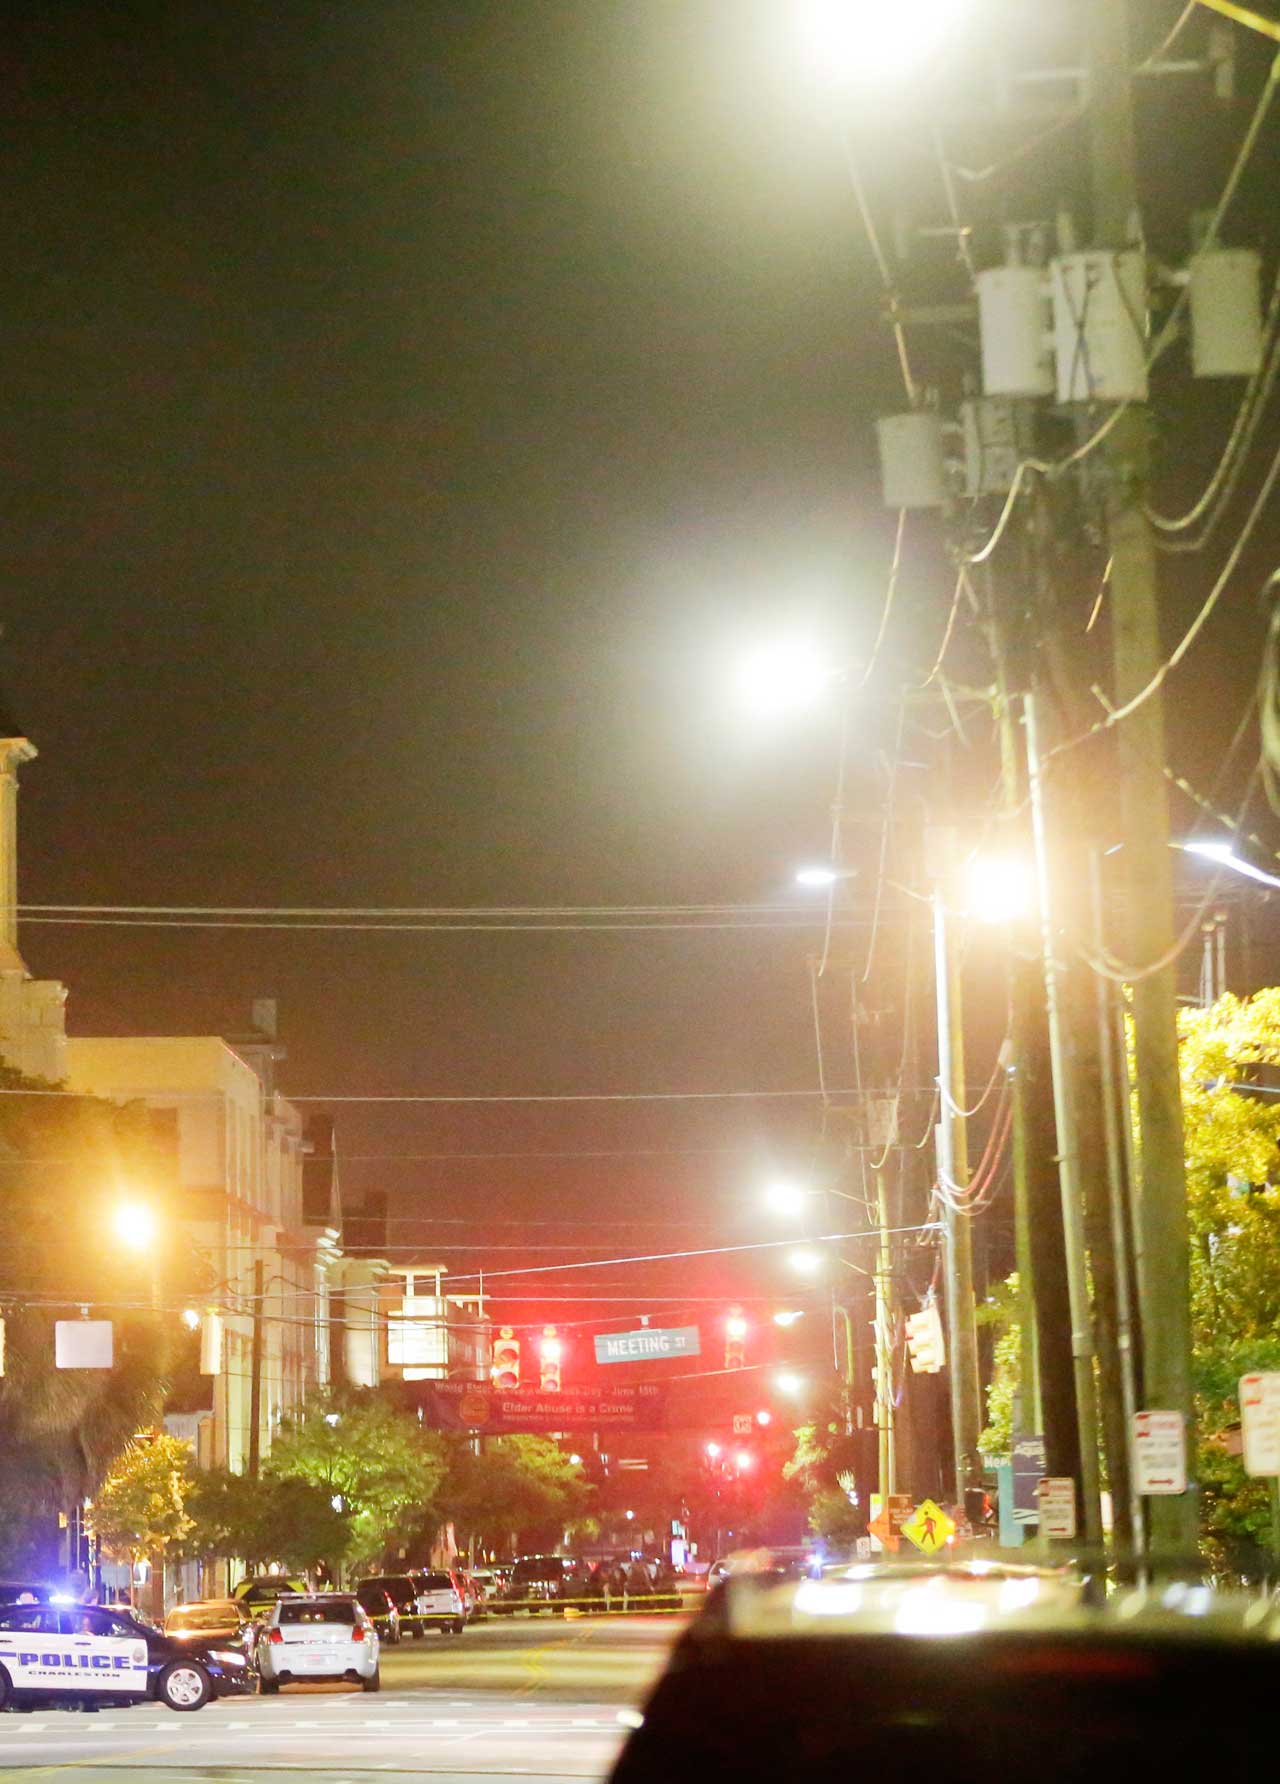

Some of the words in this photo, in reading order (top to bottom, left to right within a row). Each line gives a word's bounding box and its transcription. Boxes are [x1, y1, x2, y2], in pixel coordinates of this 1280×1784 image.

[607, 1336, 669, 1357] MEETING
[674, 1336, 686, 1347] ST
[503, 1402, 532, 1413] Elder
[535, 1403, 571, 1413] Abuse
[18, 1653, 131, 1669] POLICE
